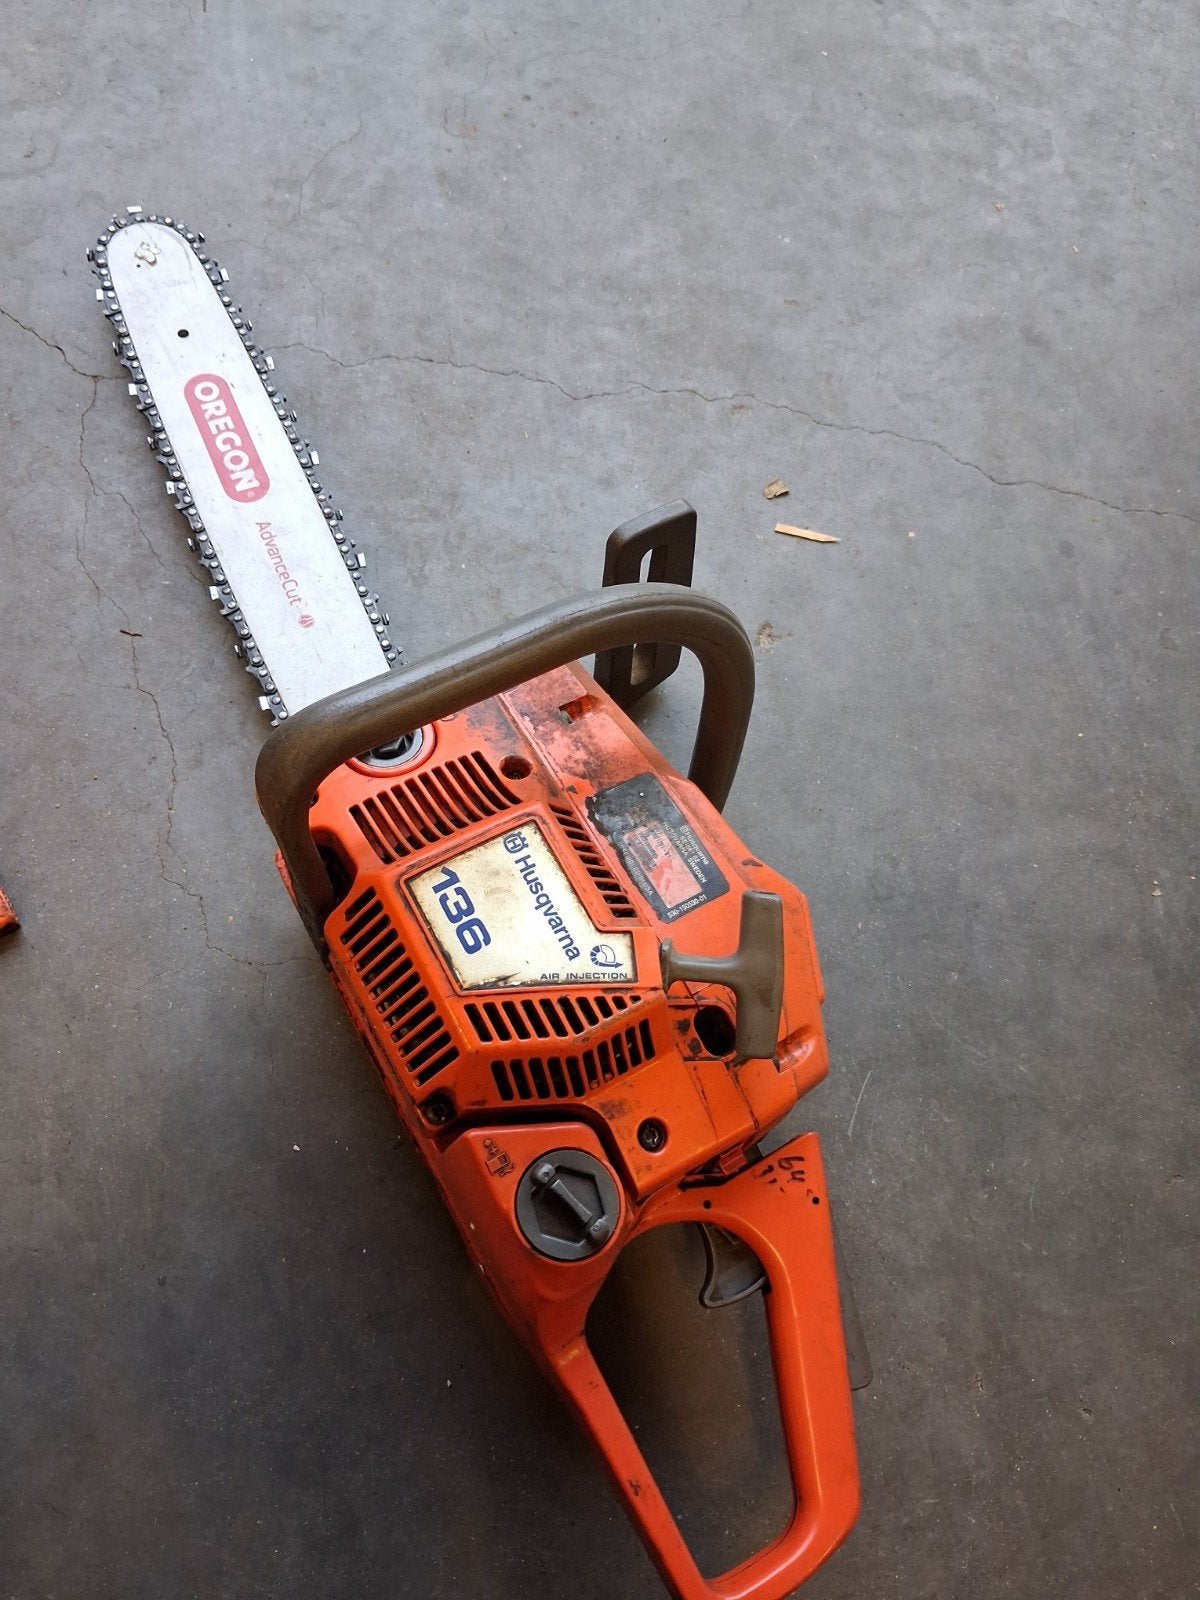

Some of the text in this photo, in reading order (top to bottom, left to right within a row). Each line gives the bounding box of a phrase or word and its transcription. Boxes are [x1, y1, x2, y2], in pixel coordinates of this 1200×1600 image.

[194, 381, 260, 493] OREGON
[255, 522, 303, 606] AdvanceCut
[432, 866, 492, 955] 136
[514, 854, 581, 961] Husqvarna
[641, 881, 655, 897] USA
[687, 857, 707, 884] SWEDEN
[566, 972, 628, 980] INJECTION
